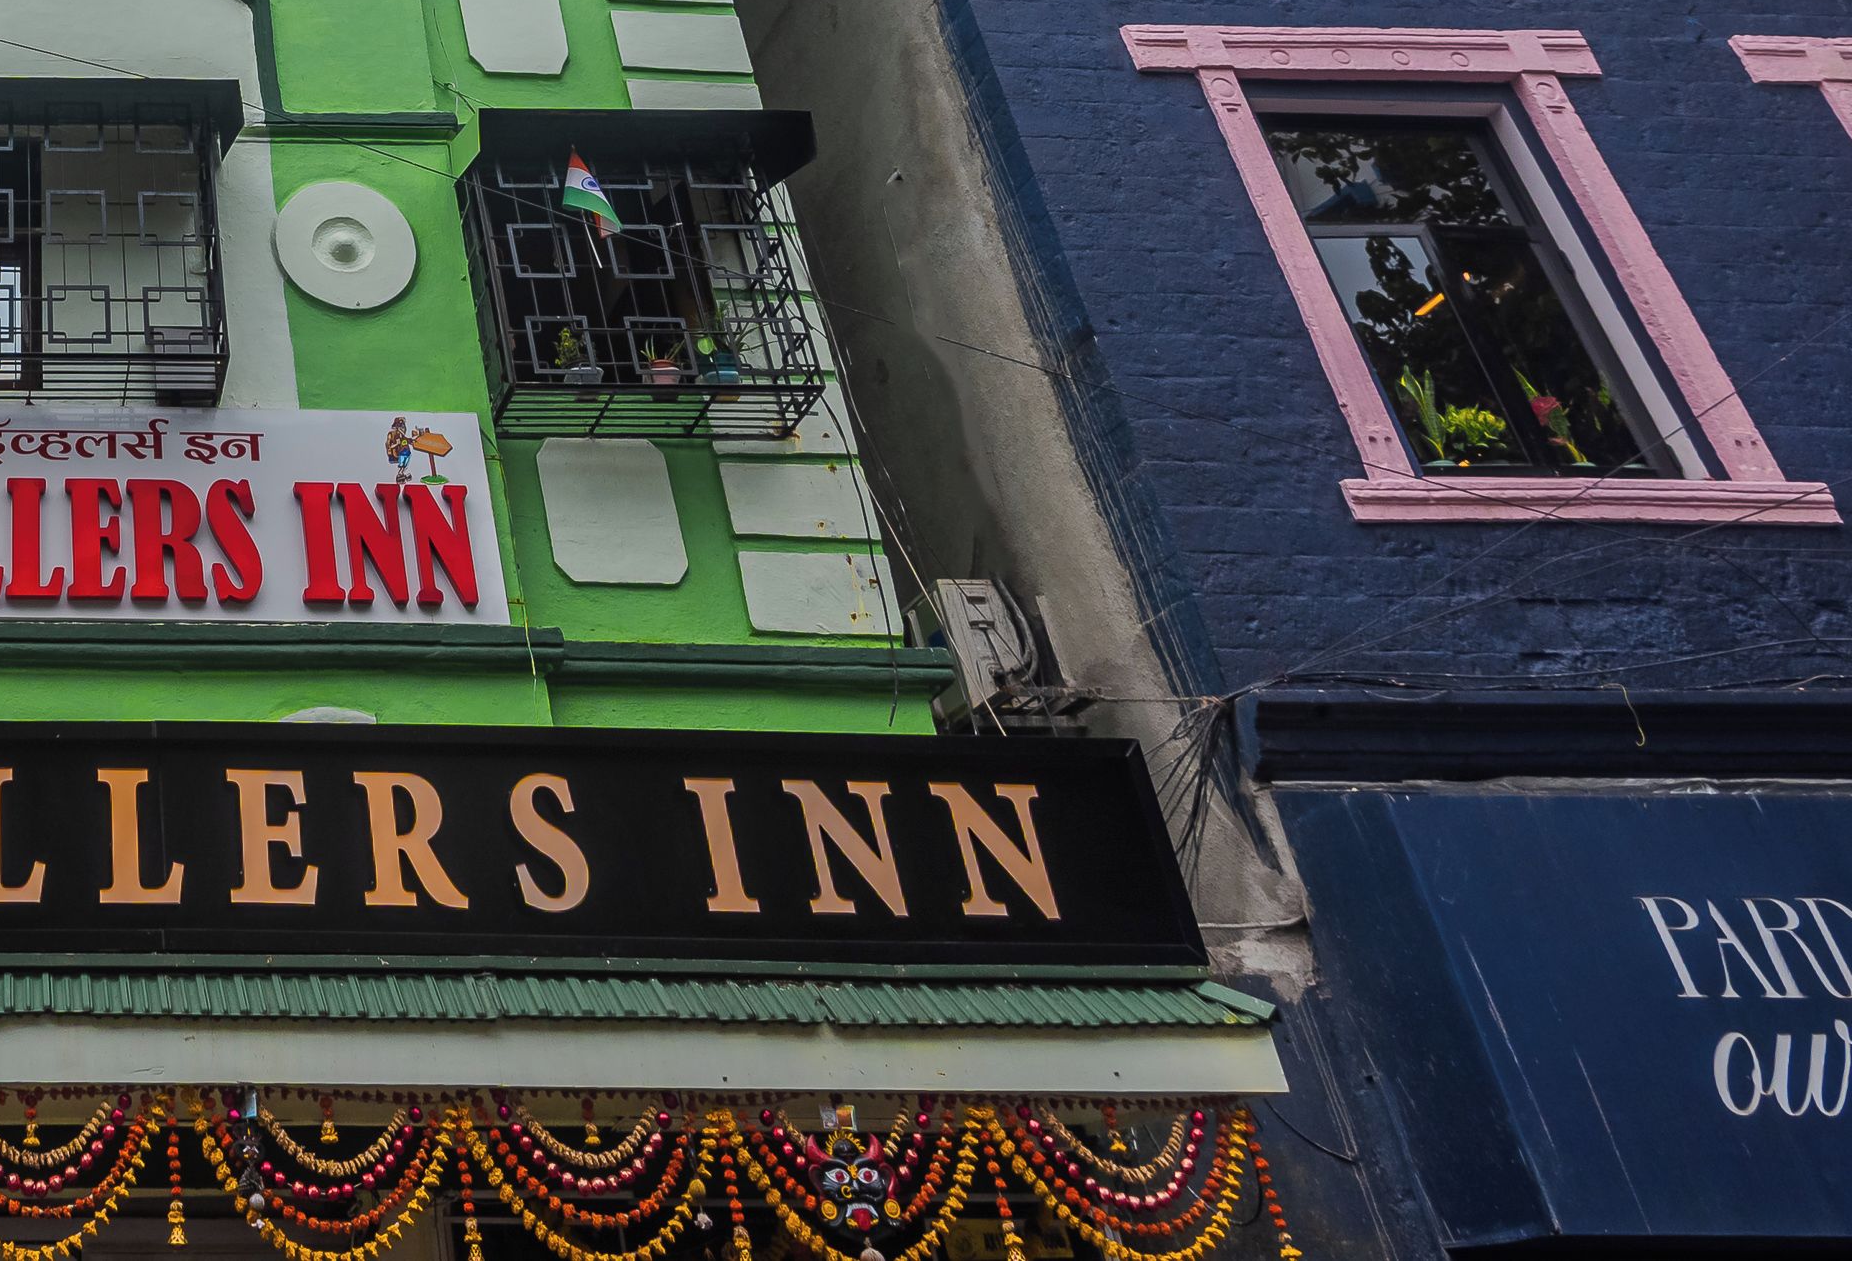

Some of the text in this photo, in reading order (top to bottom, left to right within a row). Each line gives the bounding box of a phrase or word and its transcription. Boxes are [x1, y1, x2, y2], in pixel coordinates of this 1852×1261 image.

[179, 431, 264, 465] इन
[293, 481, 481, 608] INN
[684, 777, 1061, 920] INN
